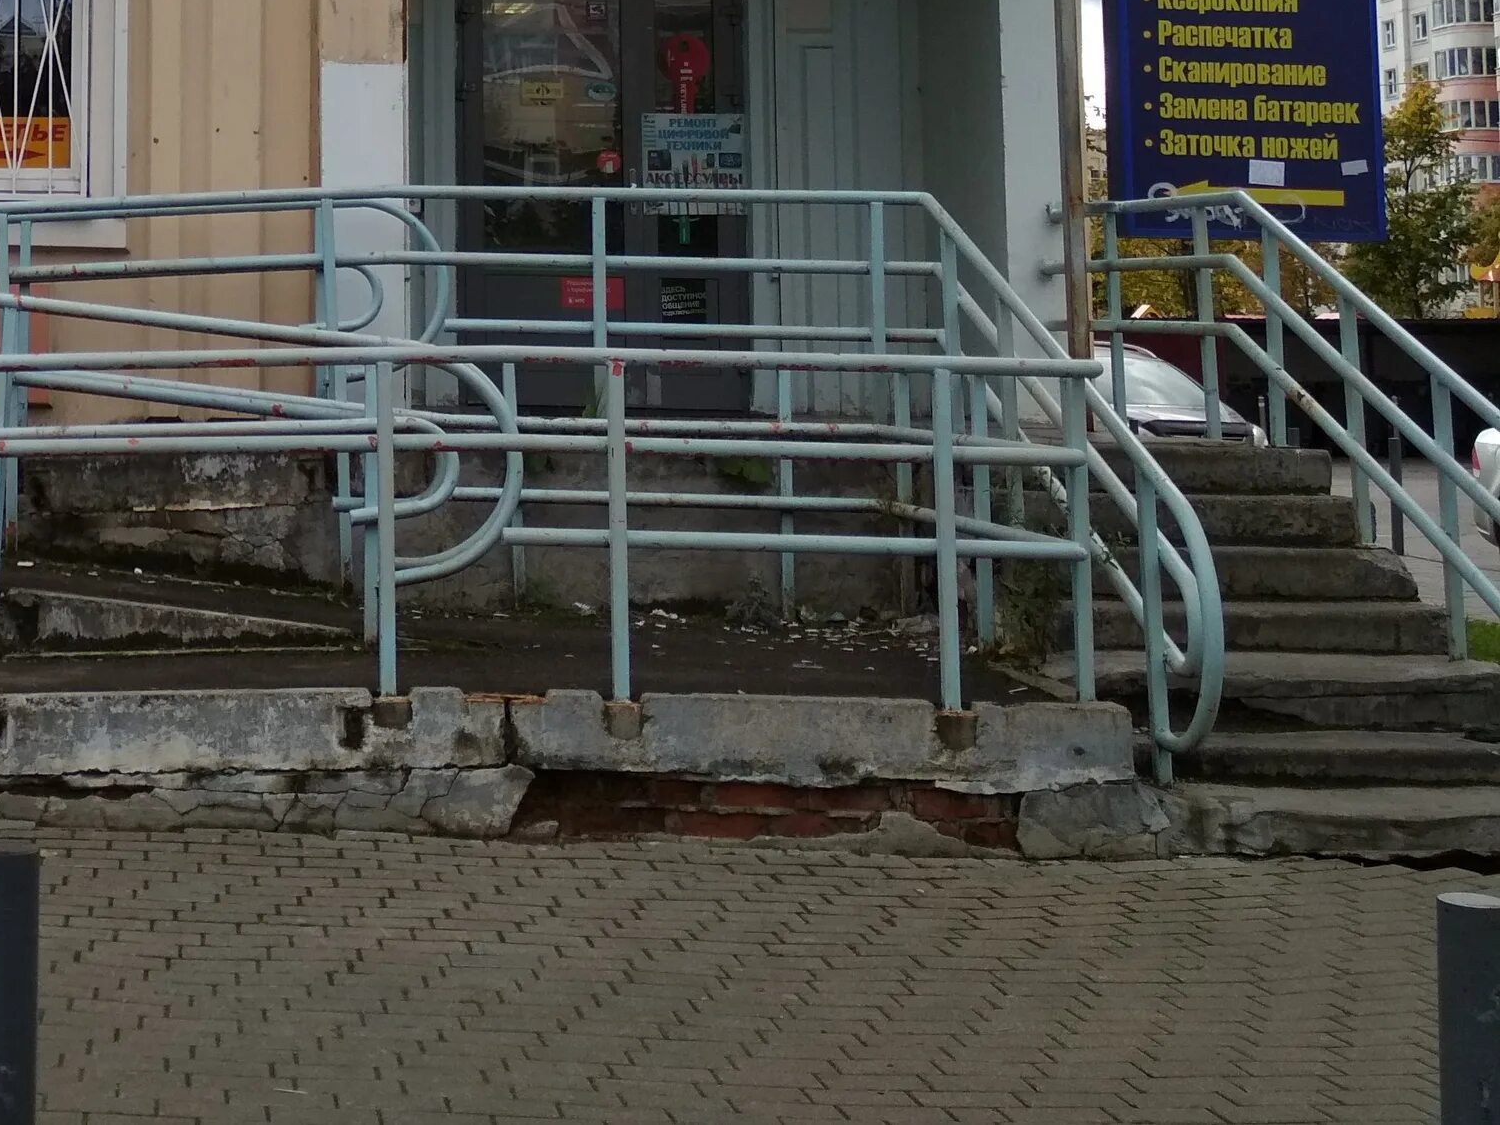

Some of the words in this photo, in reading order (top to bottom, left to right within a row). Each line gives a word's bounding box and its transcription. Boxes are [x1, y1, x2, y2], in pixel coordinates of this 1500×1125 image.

[1158, 20, 1293, 50] Распечатка
[1158, 56, 1327, 88] Сканирование
[1159, 91, 1248, 121] Замена
[1254, 93, 1360, 125] батареек
[668, 118, 717, 128] РЕМОНТ
[658, 128, 730, 140] ЦИФРОВОЙ
[1160, 127, 1256, 159] Заточка
[1261, 130, 1339, 162] ножей
[665, 140, 723, 151] ТЕХНИКИ
[645, 172, 743, 185] АКСЕССУАРЫ
